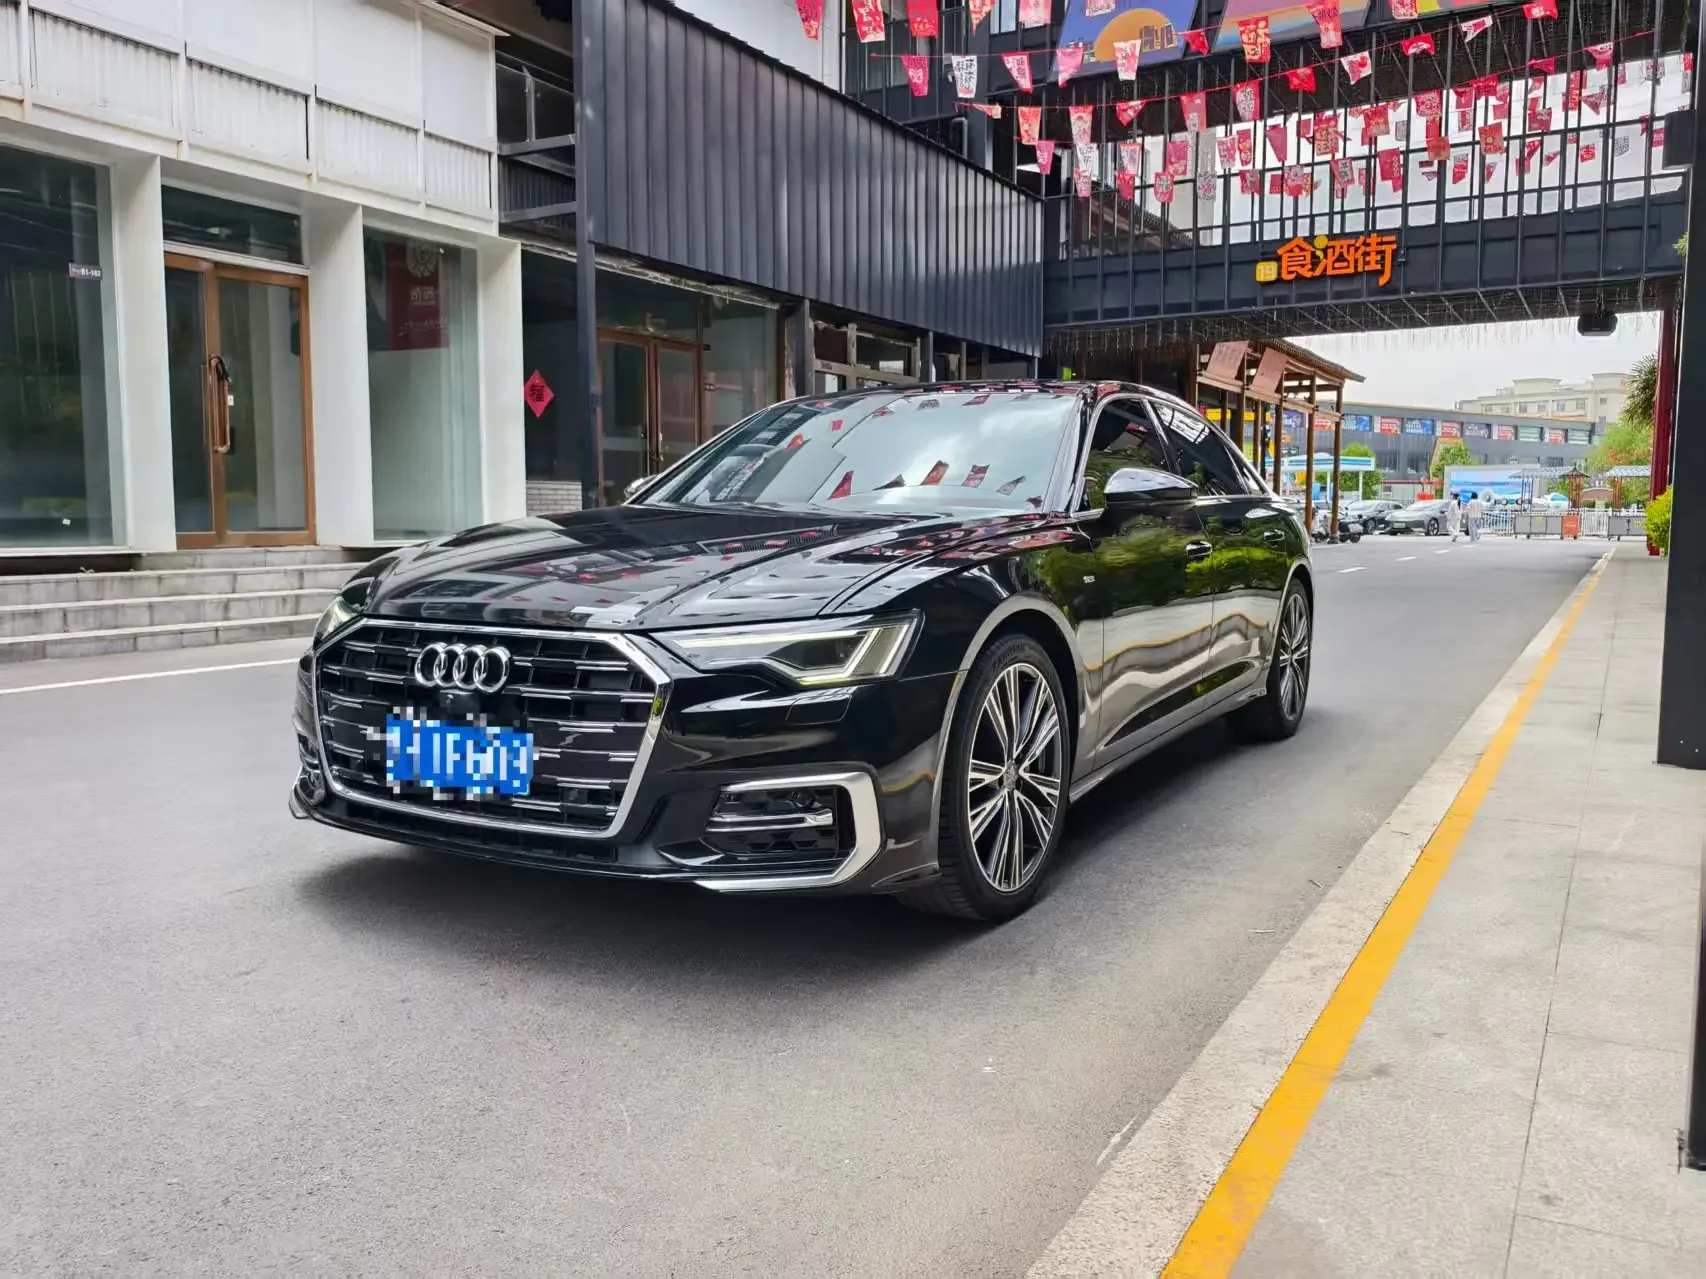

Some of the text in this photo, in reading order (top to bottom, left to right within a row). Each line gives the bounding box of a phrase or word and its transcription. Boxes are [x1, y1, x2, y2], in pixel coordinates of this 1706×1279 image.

[1275, 232, 1397, 287] 食酒街
[528, 383, 545, 404] 福
